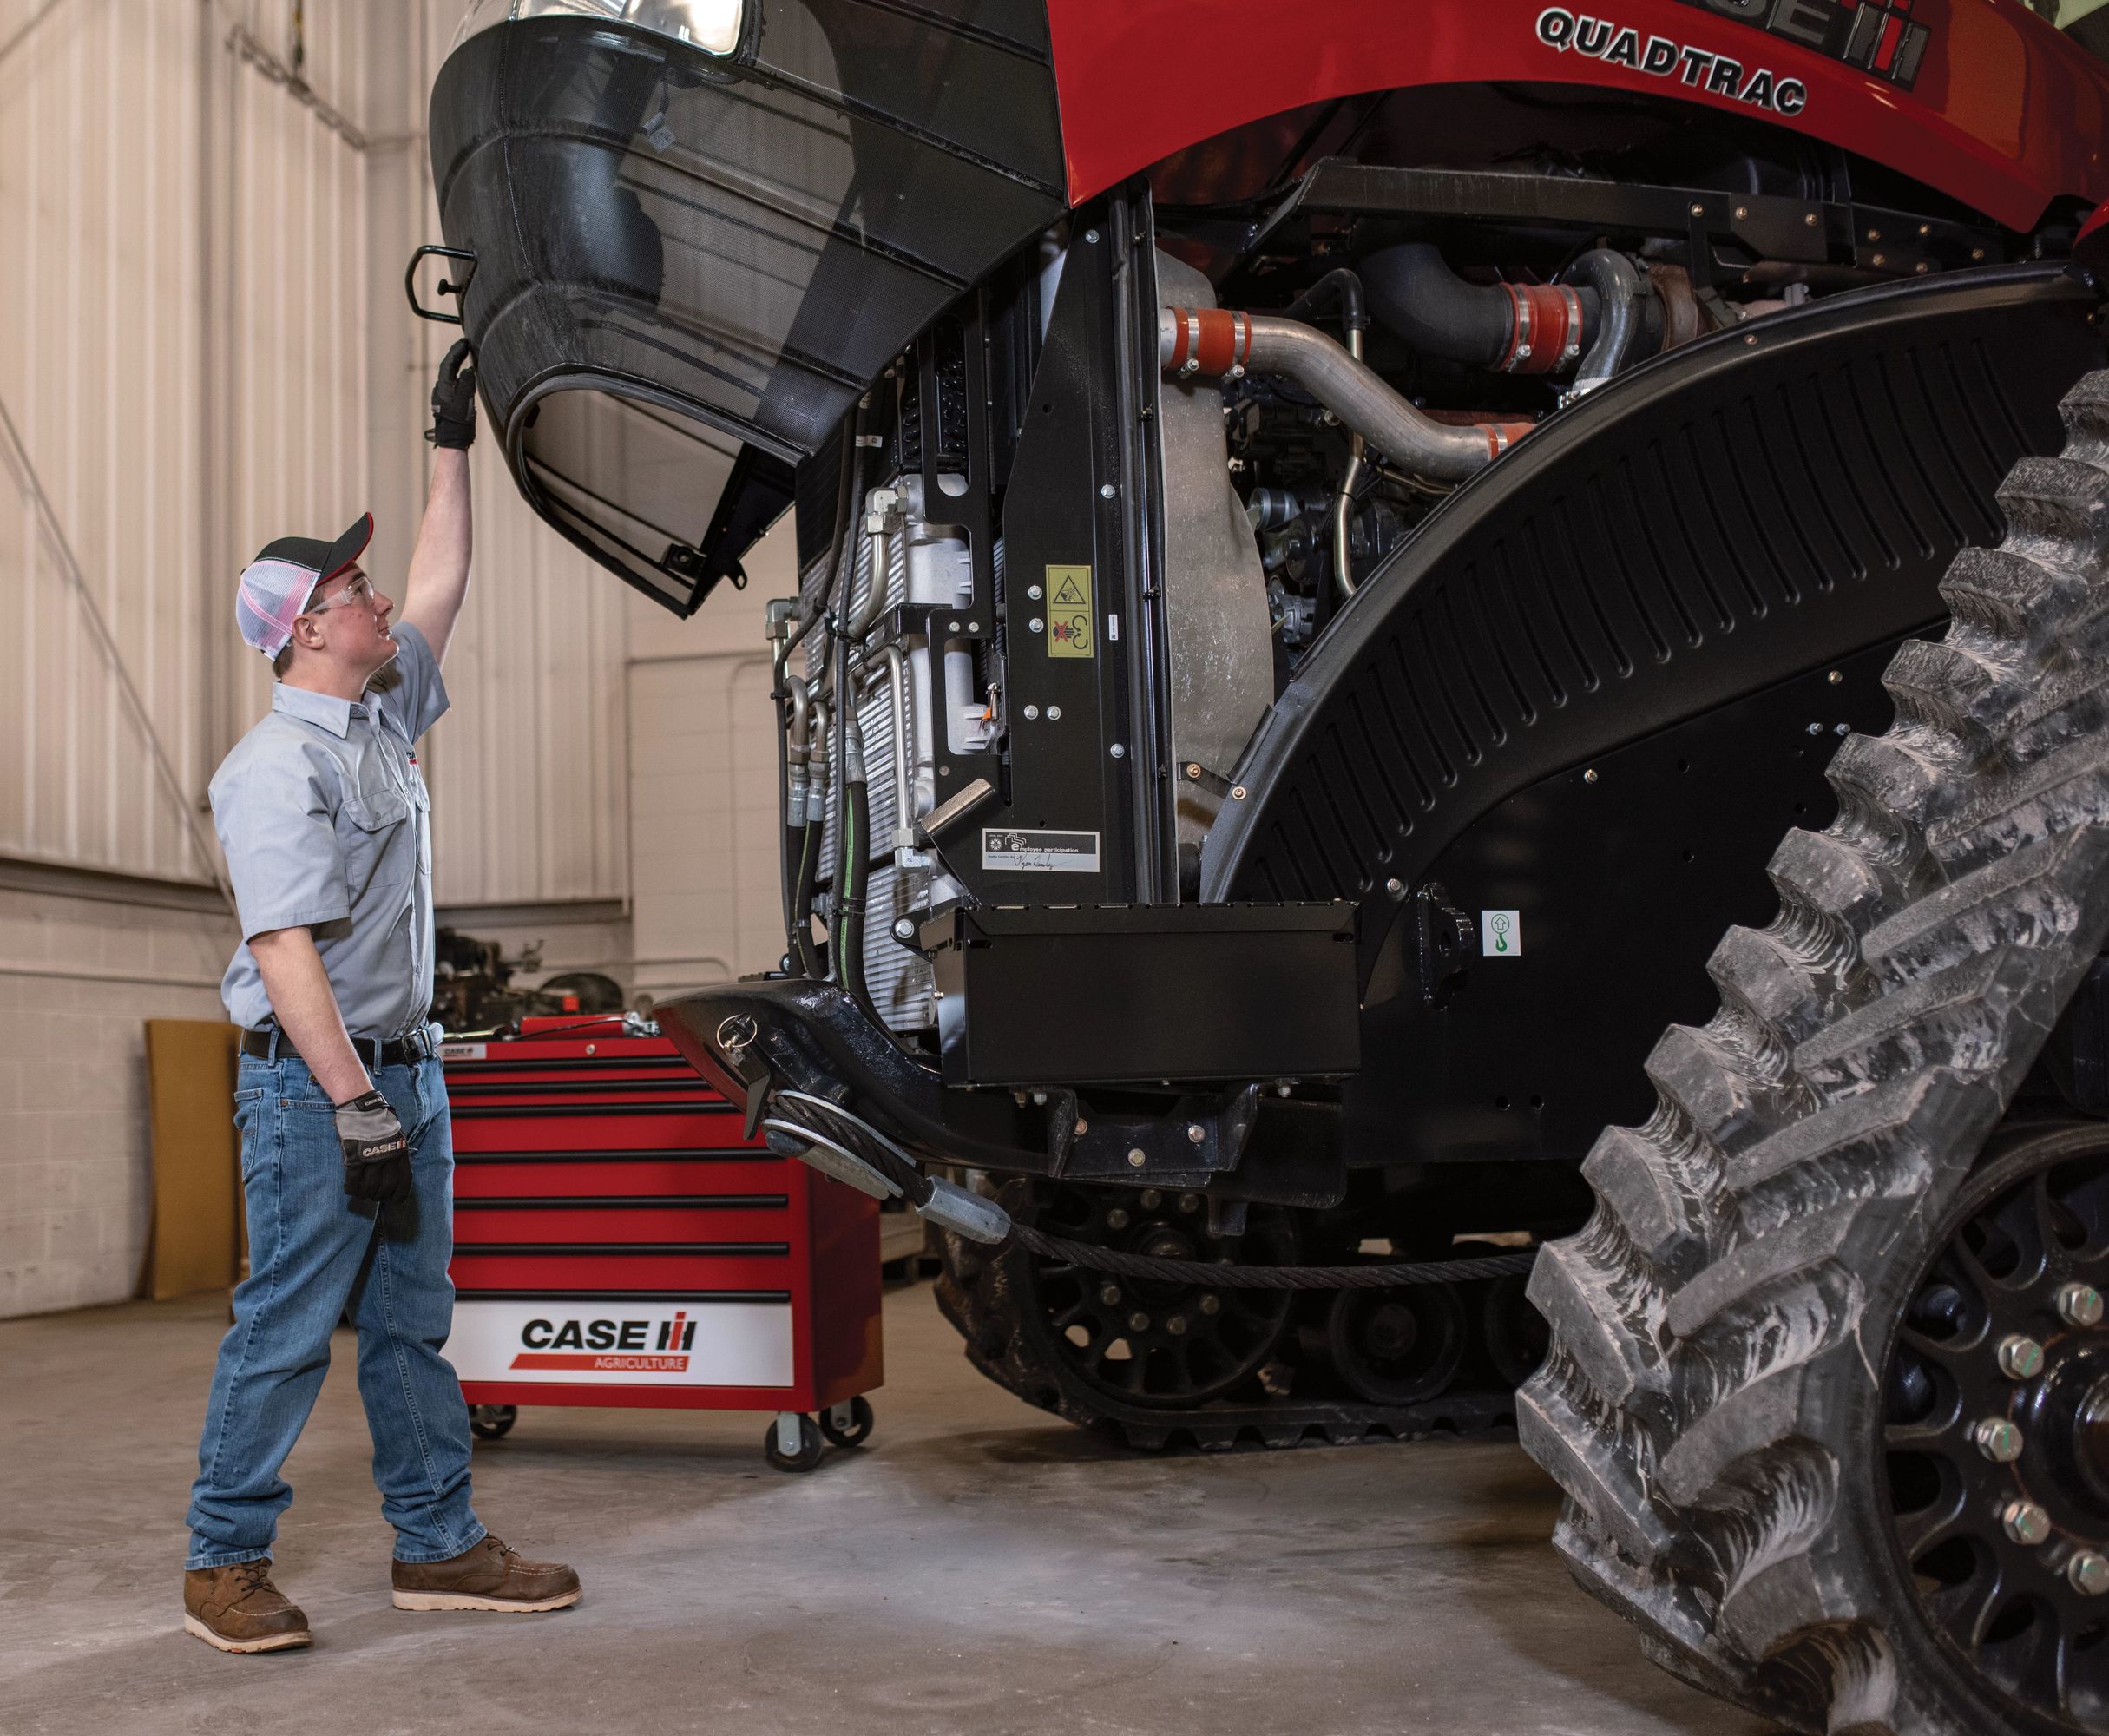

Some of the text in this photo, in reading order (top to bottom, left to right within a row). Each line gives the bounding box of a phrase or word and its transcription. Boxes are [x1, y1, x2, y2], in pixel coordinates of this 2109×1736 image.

[1535, 6, 1808, 116] QUADTRAC
[362, 1141, 397, 1157] CASE
[522, 1318, 649, 1350] CASE
[594, 1357, 684, 1370] AGRICULTURE
